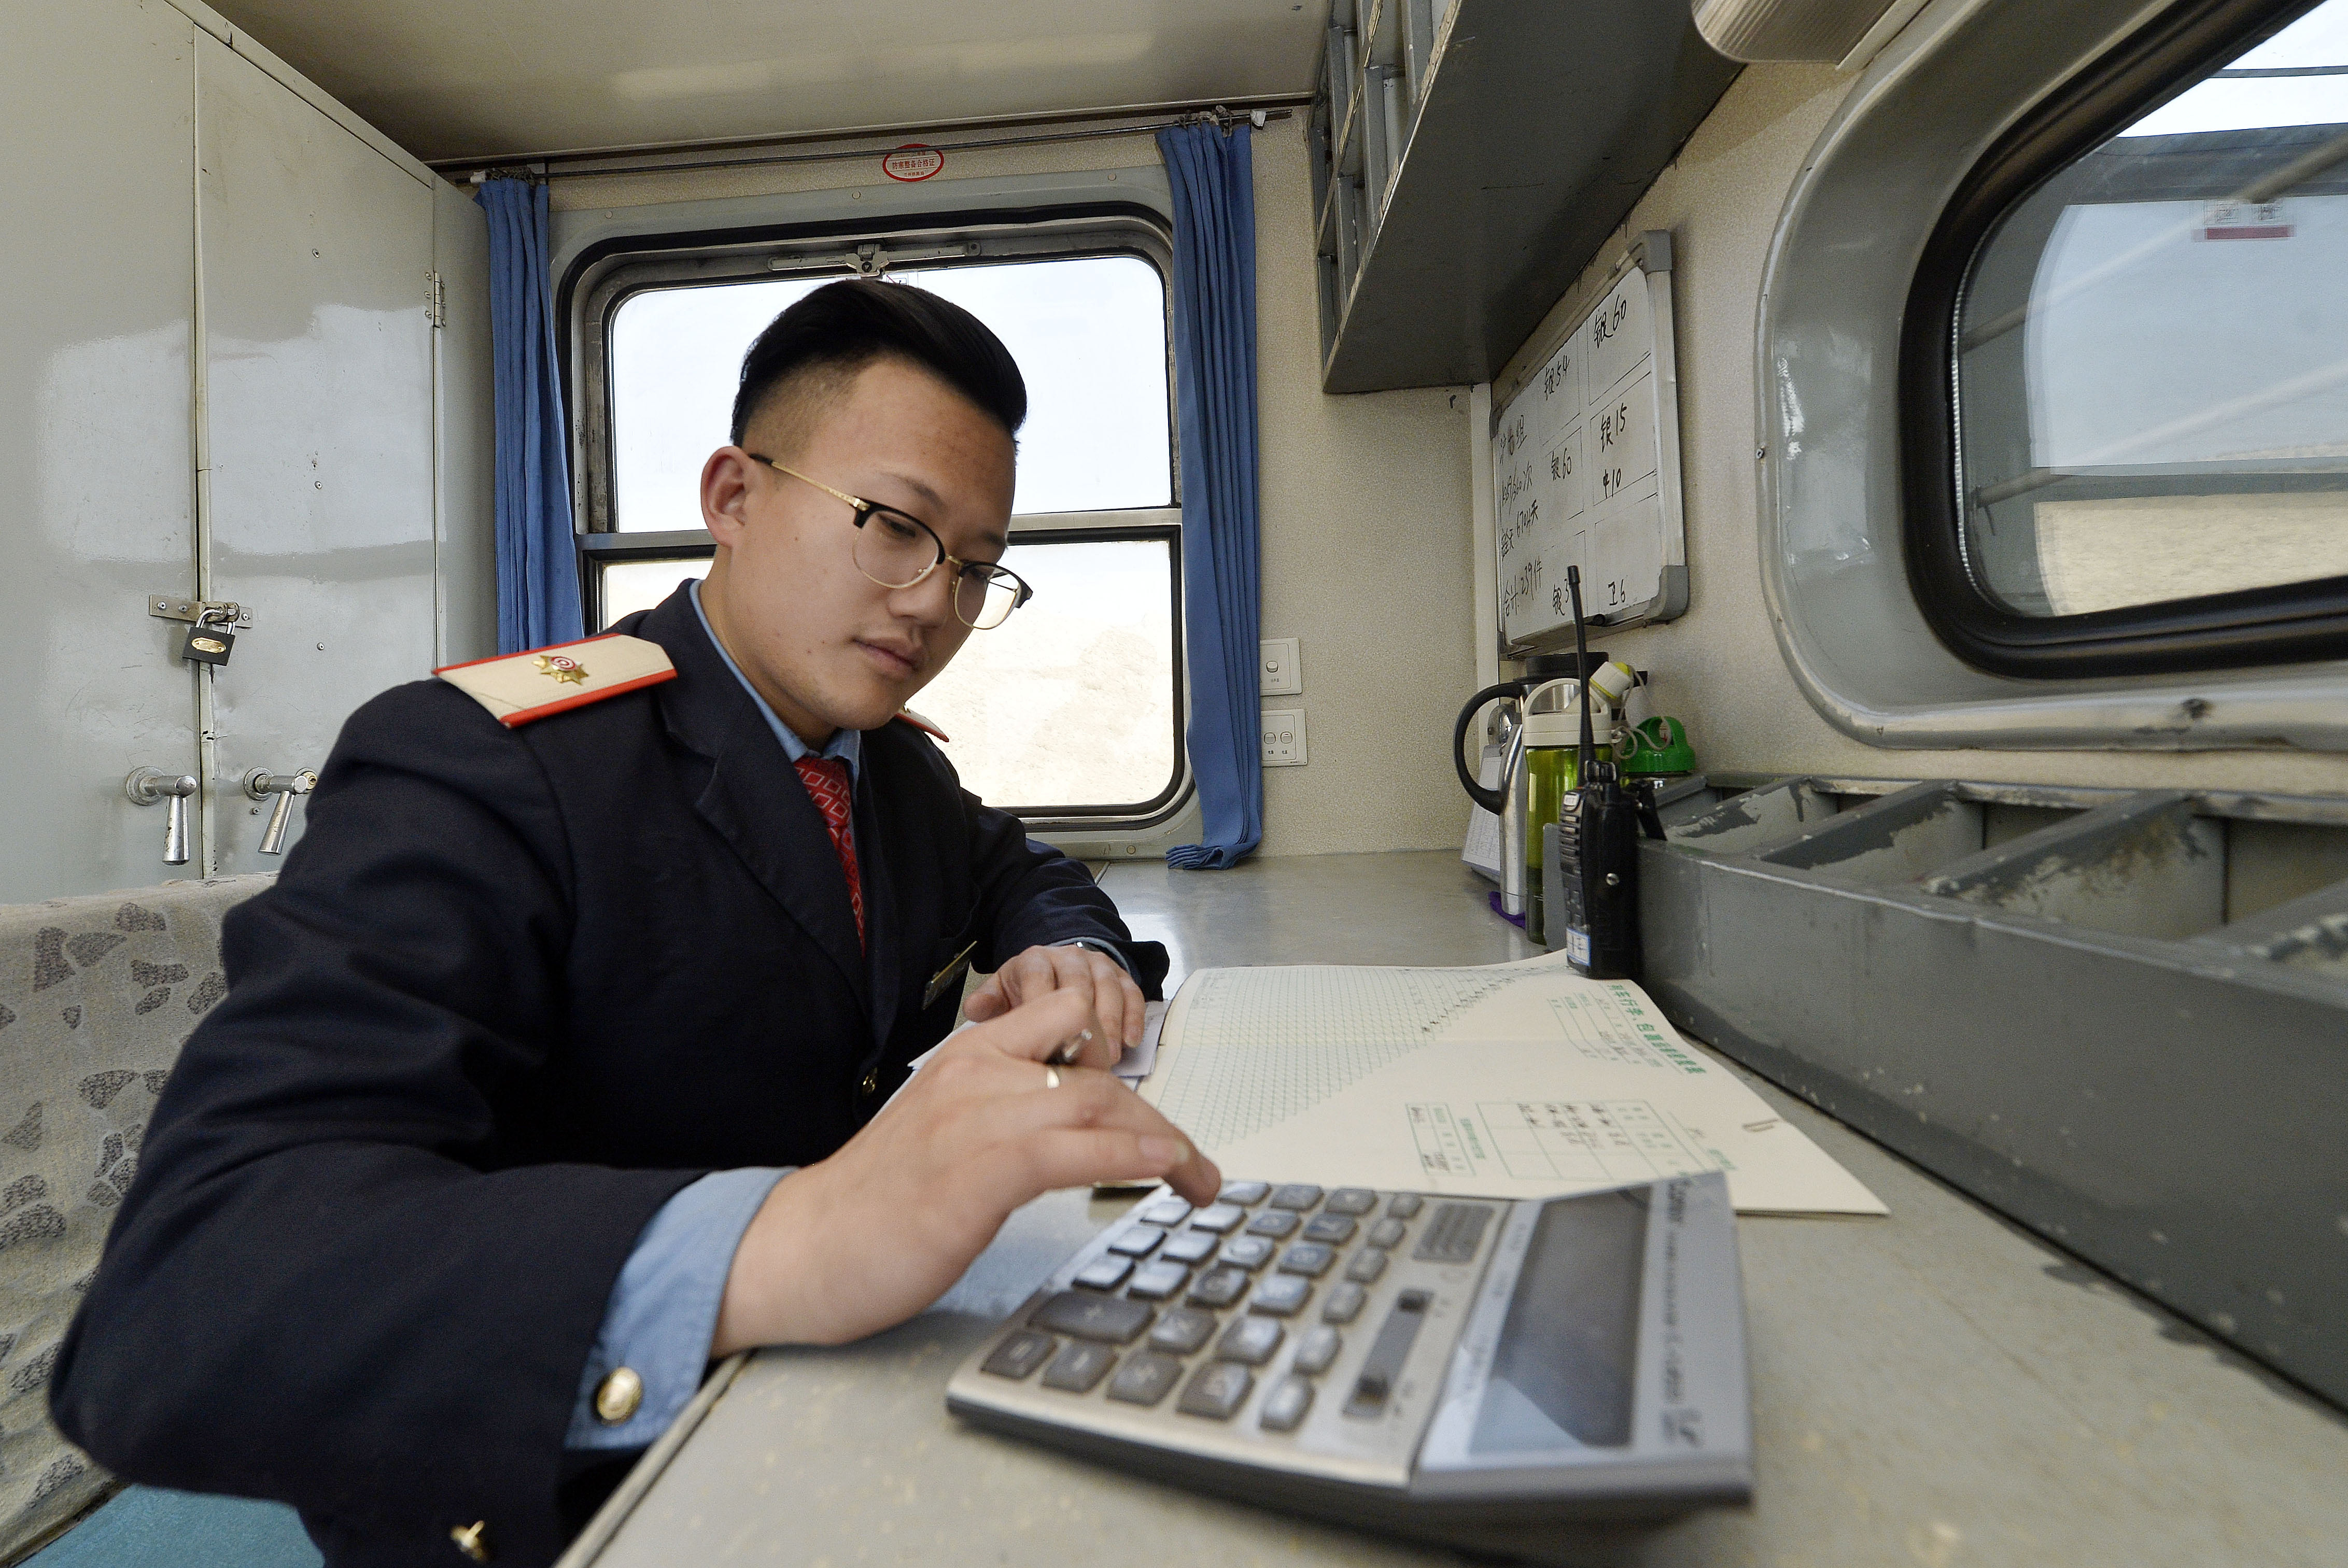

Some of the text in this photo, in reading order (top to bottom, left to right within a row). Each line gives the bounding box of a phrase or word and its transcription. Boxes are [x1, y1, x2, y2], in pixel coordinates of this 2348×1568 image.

[1594, 294, 1627, 349] 银60
[1600, 402, 1627, 453] 银15
[1603, 468, 1622, 499] 中10
